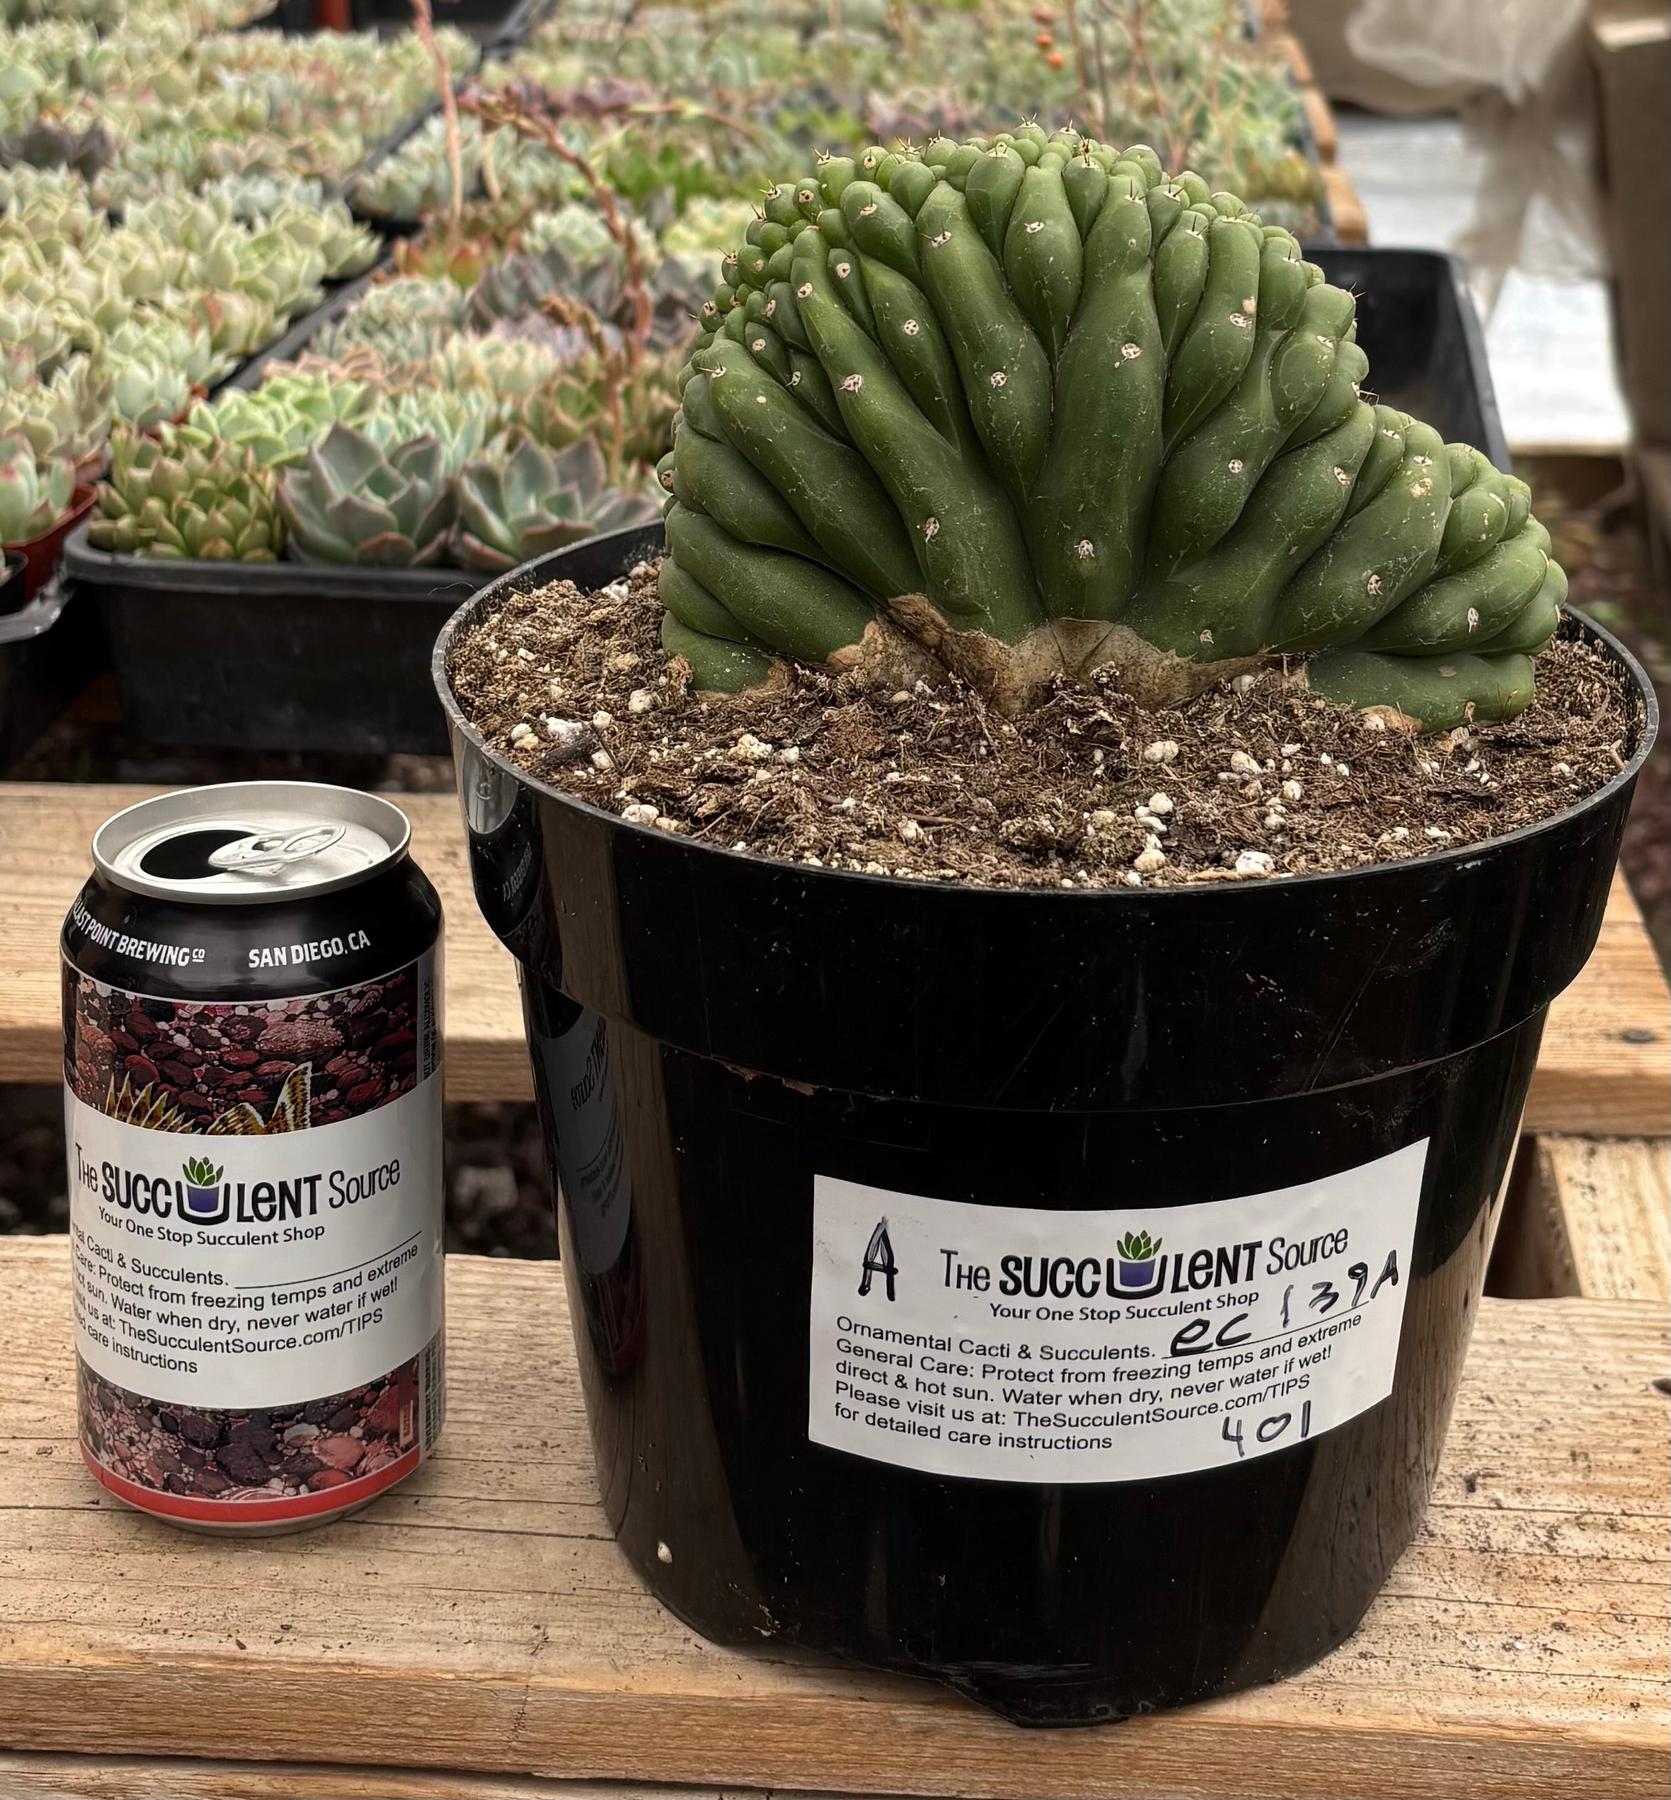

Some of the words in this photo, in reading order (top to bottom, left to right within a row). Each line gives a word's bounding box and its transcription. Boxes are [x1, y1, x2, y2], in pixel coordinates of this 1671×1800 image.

[84, 918, 120, 950] POINT
[116, 935, 190, 967] BREWING
[249, 946, 287, 968] SAN
[292, 938, 348, 965] DIEGO,
[348, 930, 371, 950] CA
[329, 1158, 400, 1209] Source
[98, 1205, 123, 1228] Your
[126, 1220, 154, 1238] One
[157, 1225, 193, 1246] Stop
[197, 1228, 279, 1247] Succulent
[284, 1224, 325, 1242] Shop
[1266, 1228, 1349, 1275] Source
[87, 1235, 113, 1263] Cacti
[117, 1253, 127, 1268] &
[131, 1258, 229, 1287] Succulents.
[99, 1265, 144, 1297] Protect
[149, 1282, 186, 1305] from
[192, 1292, 264, 1311] freezing
[272, 1283, 326, 1306] temps
[332, 1275, 363, 1296] and
[367, 1245, 419, 1282] extreme
[858, 1216, 898, 1302] A
[87, 1281, 107, 1304] sun.
[111, 1293, 151, 1320] Water
[157, 1311, 202, 1330] when
[208, 1314, 240, 1334] dry,
[247, 1315, 299, 1331] never
[305, 1302, 353, 1325] water
[357, 1292, 367, 1309] if
[371, 1276, 398, 1302] wet!
[88, 1303, 99, 1320] us
[119, 1307, 383, 1354] TheSucculentSource.com/TIPS
[990, 1303, 1032, 1319] Your
[1036, 1306, 1074, 1320] One
[1079, 1304, 1121, 1323] Stop
[1125, 1299, 1212, 1320] Succulent
[1216, 1290, 1260, 1309] Shop
[88, 1325, 108, 1347] care
[112, 1336, 198, 1374] instructions
[836, 1338, 913, 1368] General
[920, 1356, 974, 1378] Care:
[982, 1364, 1054, 1383] Protect
[1060, 1367, 1106, 1383] from
[1112, 1361, 1191, 1382] freezing
[1198, 1351, 1254, 1374] temps
[1259, 1338, 1293, 1360] and
[1297, 1314, 1362, 1349] extreme
[837, 1316, 952, 1352] Ornamental
[959, 1339, 1010, 1358] Cacti
[1017, 1344, 1032, 1359] &
[1039, 1343, 1156, 1361] Succulents.
[836, 1360, 888, 1385] direct
[894, 1375, 908, 1390] &
[915, 1378, 947, 1396] hot
[952, 1386, 994, 1402] sun.
[1002, 1388, 1063, 1406] Water
[1069, 1390, 1122, 1406] when
[1129, 1387, 1163, 1409] dry,
[1170, 1380, 1225, 1399] never
[1229, 1365, 1281, 1389] water
[1283, 1358, 1295, 1375] if
[1299, 1344, 1332, 1369] wet!
[836, 1381, 901, 1409] Please
[907, 1400, 945, 1418] visit
[951, 1409, 975, 1422] us
[981, 1410, 1006, 1426] at:
[1014, 1374, 1310, 1428] TheSucculentSource.com/TIPS
[835, 1402, 860, 1421] for
[865, 1412, 941, 1440] detailed
[947, 1430, 992, 1447] care
[998, 1432, 1112, 1451] instructions
[1222, 1400, 1312, 1457] 401
